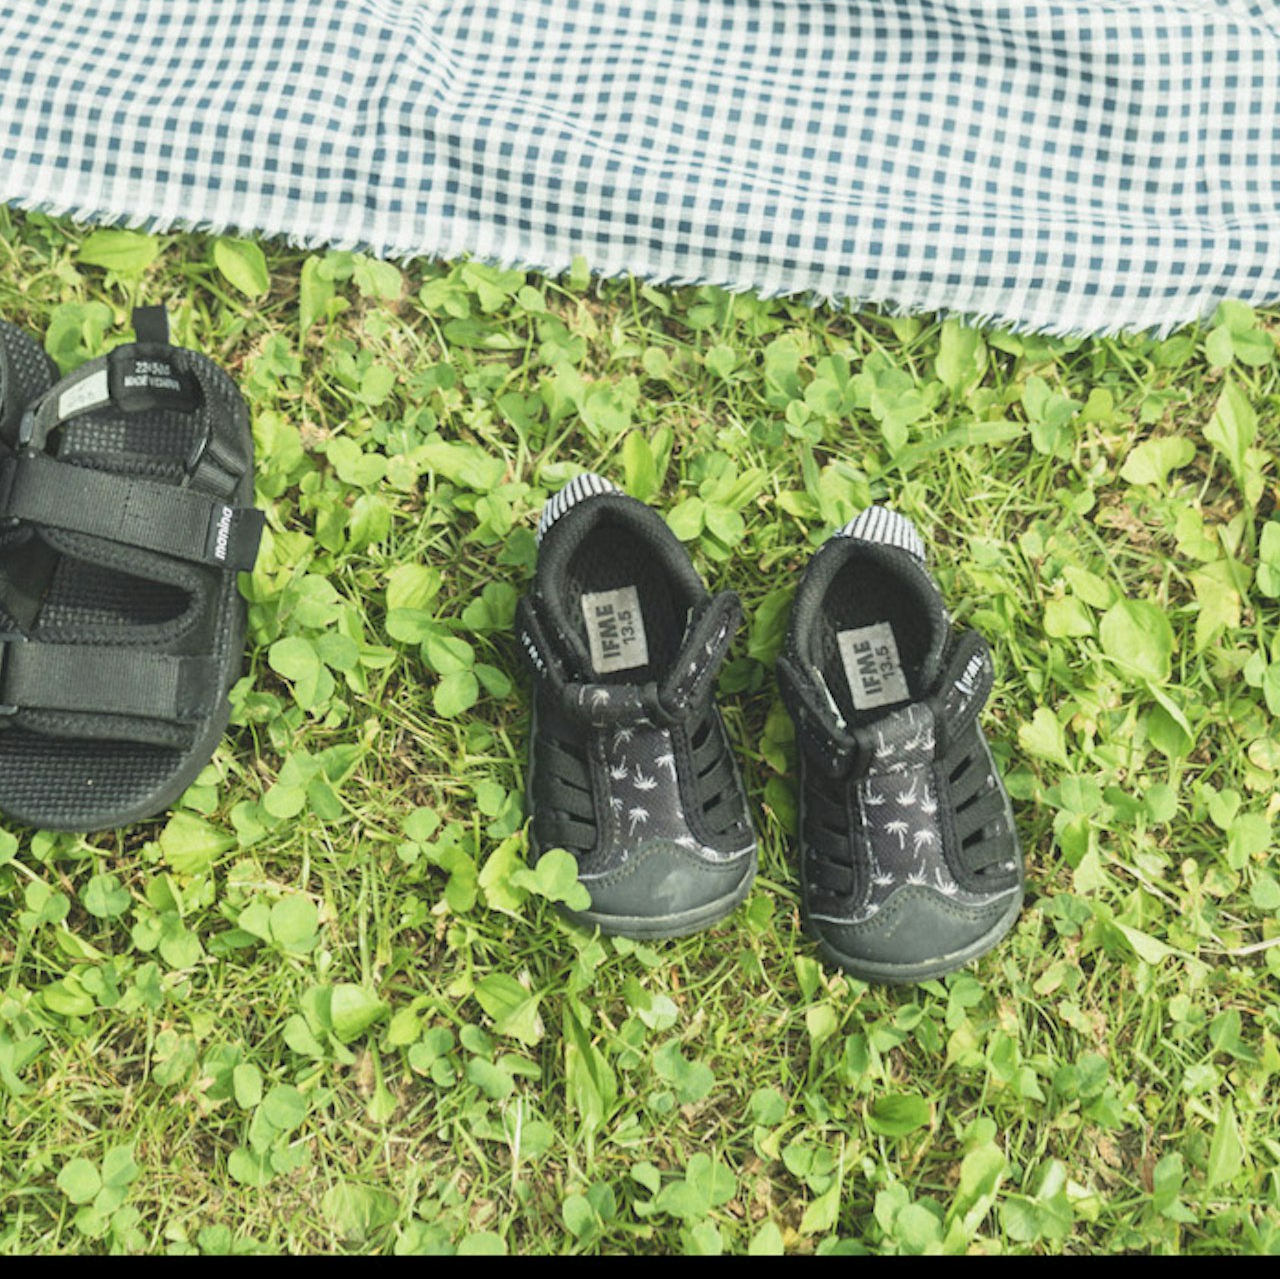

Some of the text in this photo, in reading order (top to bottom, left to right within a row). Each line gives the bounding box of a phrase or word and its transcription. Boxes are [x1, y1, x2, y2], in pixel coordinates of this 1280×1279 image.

[215, 506, 233, 561] manina
[595, 604, 622, 657] IFME
[618, 610, 636, 645] 13.5
[853, 640, 883, 695] IFME
[875, 646, 894, 680] 13.5
